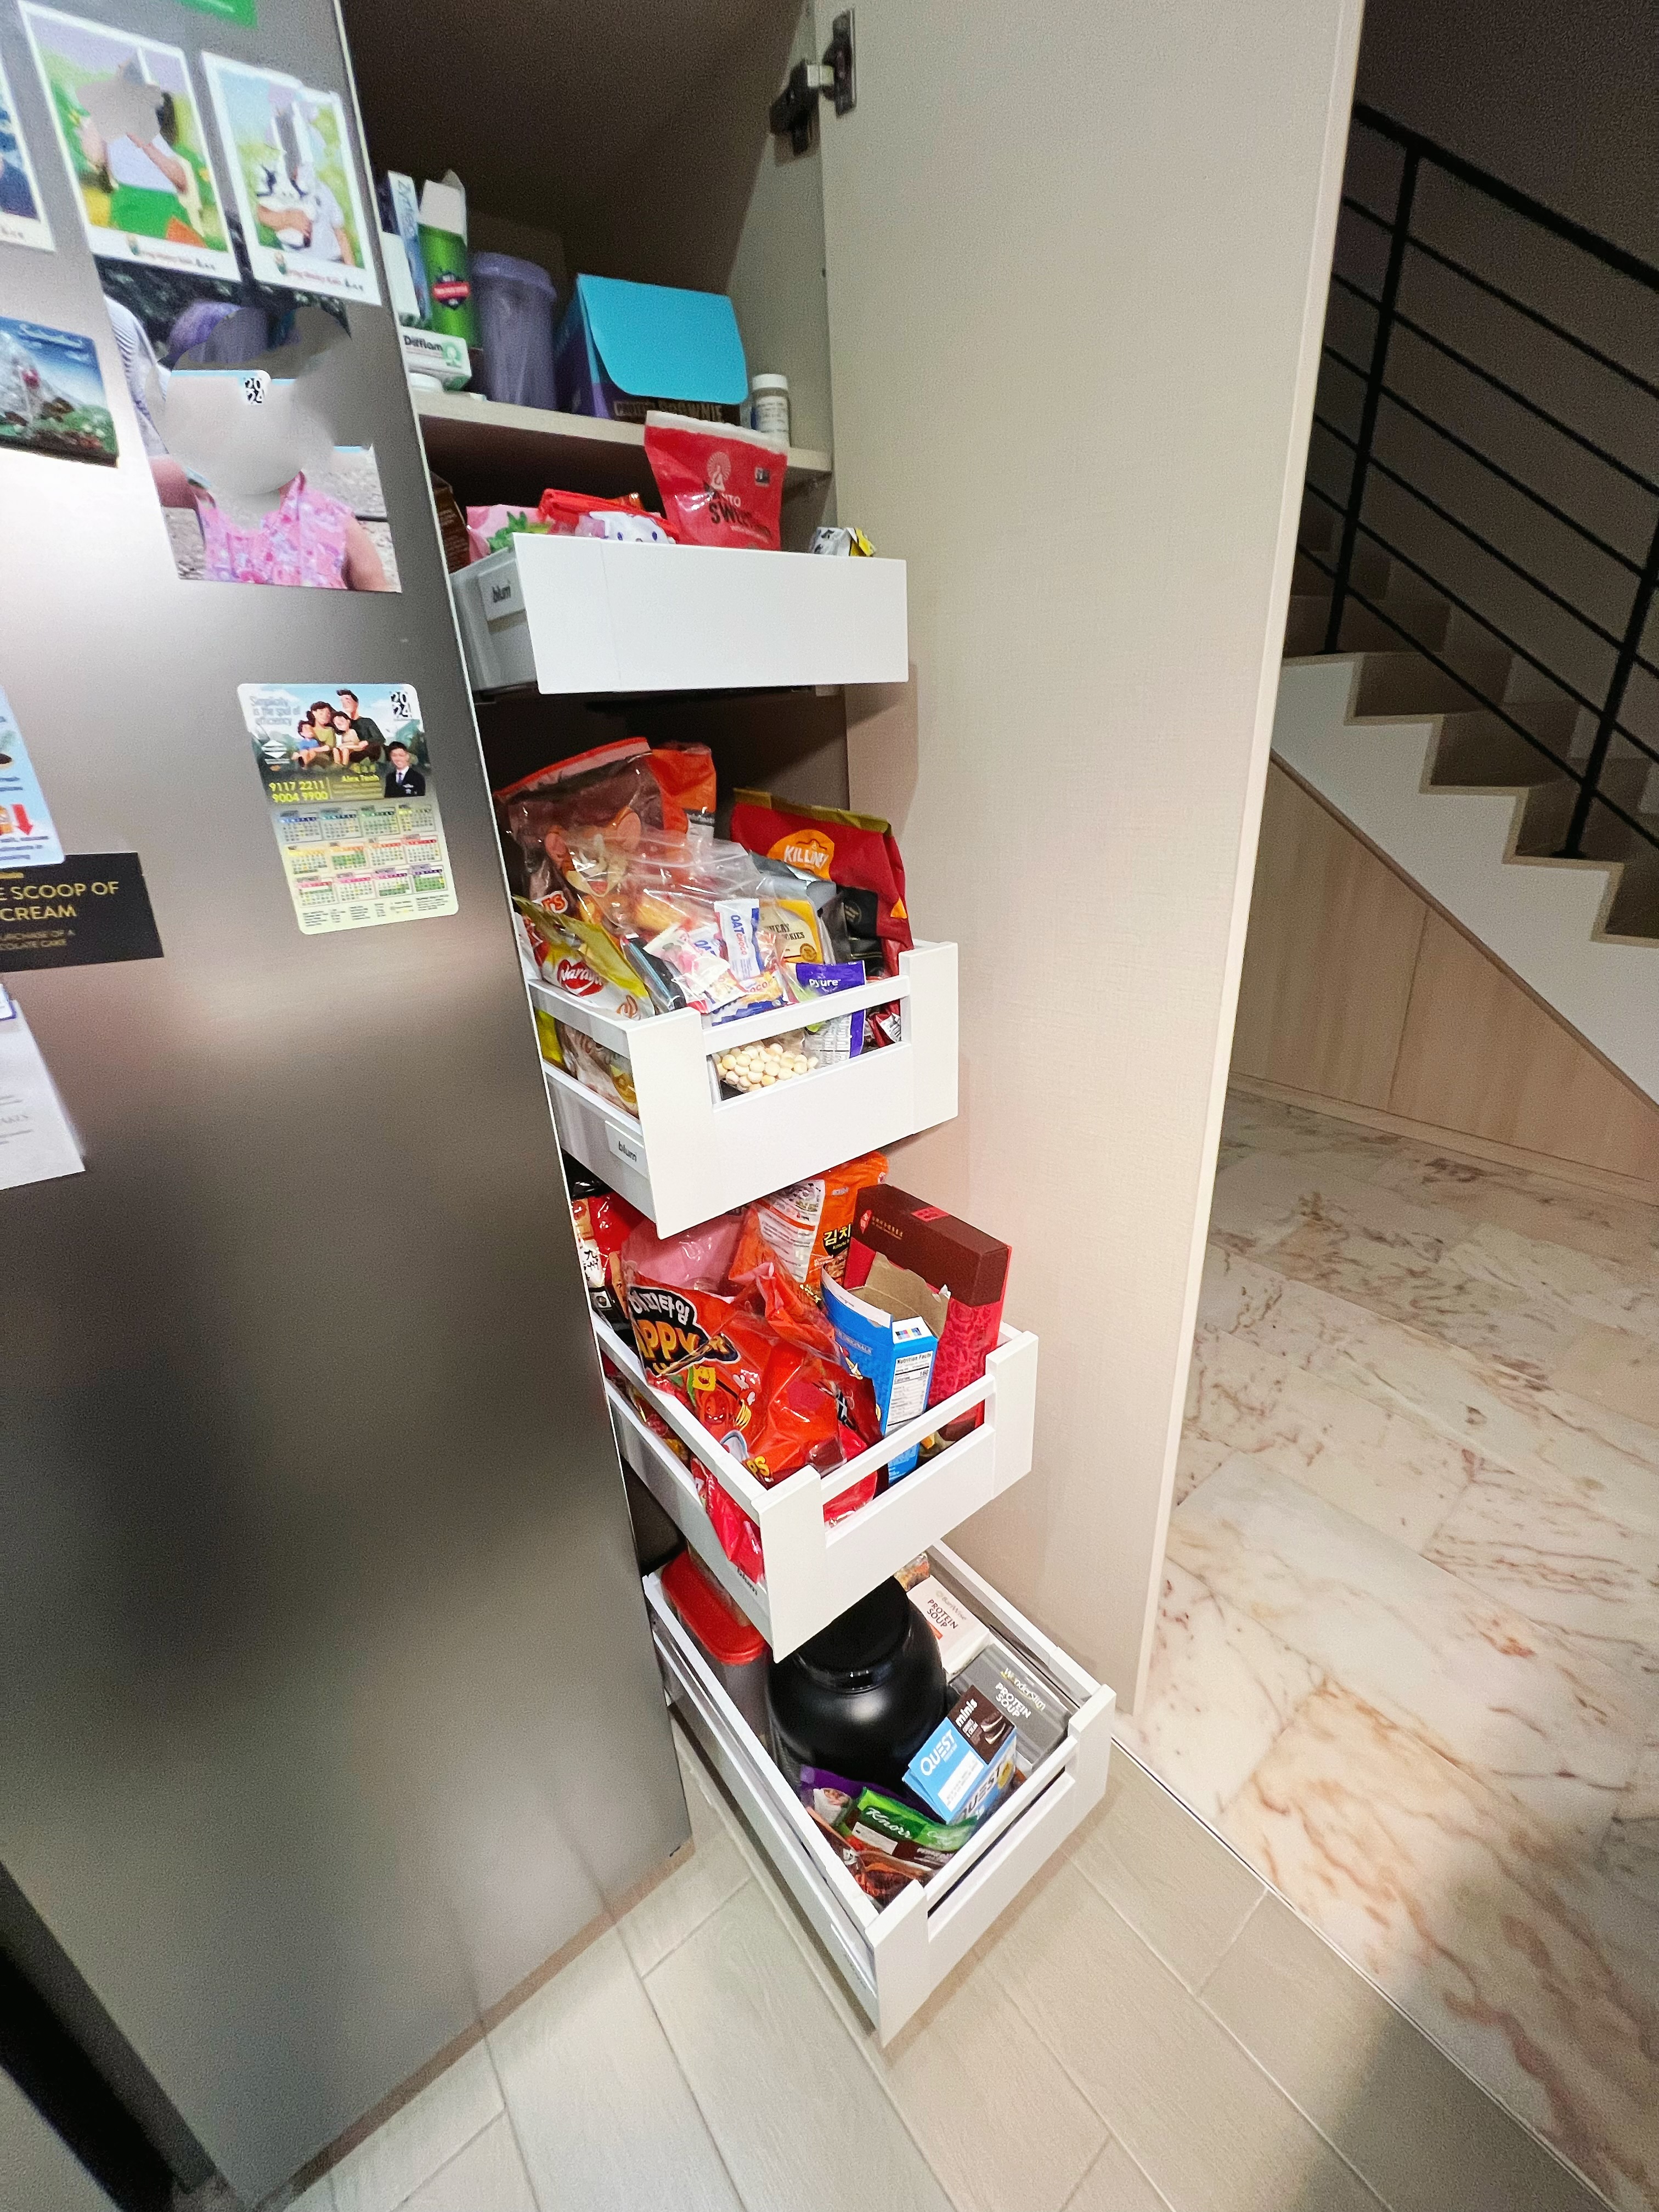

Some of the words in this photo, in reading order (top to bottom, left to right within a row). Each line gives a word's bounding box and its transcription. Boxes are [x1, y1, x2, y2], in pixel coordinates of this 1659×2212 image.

[269, 781, 296, 791] 9117
[298, 780, 324, 791] 2211
[272, 793, 300, 803] 9004
[10, 883, 87, 900] SCOOP
[91, 881, 119, 895] OF
[0, 905, 77, 921] CREAM
[731, 915, 746, 936] OAT
[618, 1141, 637, 1162] blum
[824, 1223, 851, 1246] 김치
[896, 1356, 918, 1364] Nutrition
[918, 1352, 932, 1361] Facts
[927, 1599, 958, 1629] PROTEIN
[927, 1608, 947, 1627] SOUP
[995, 1682, 1032, 1718] PROTEIN
[996, 1694, 1020, 1717] SOUP
[955, 1699, 978, 1728] minis
[920, 1729, 956, 1776] QUEST
